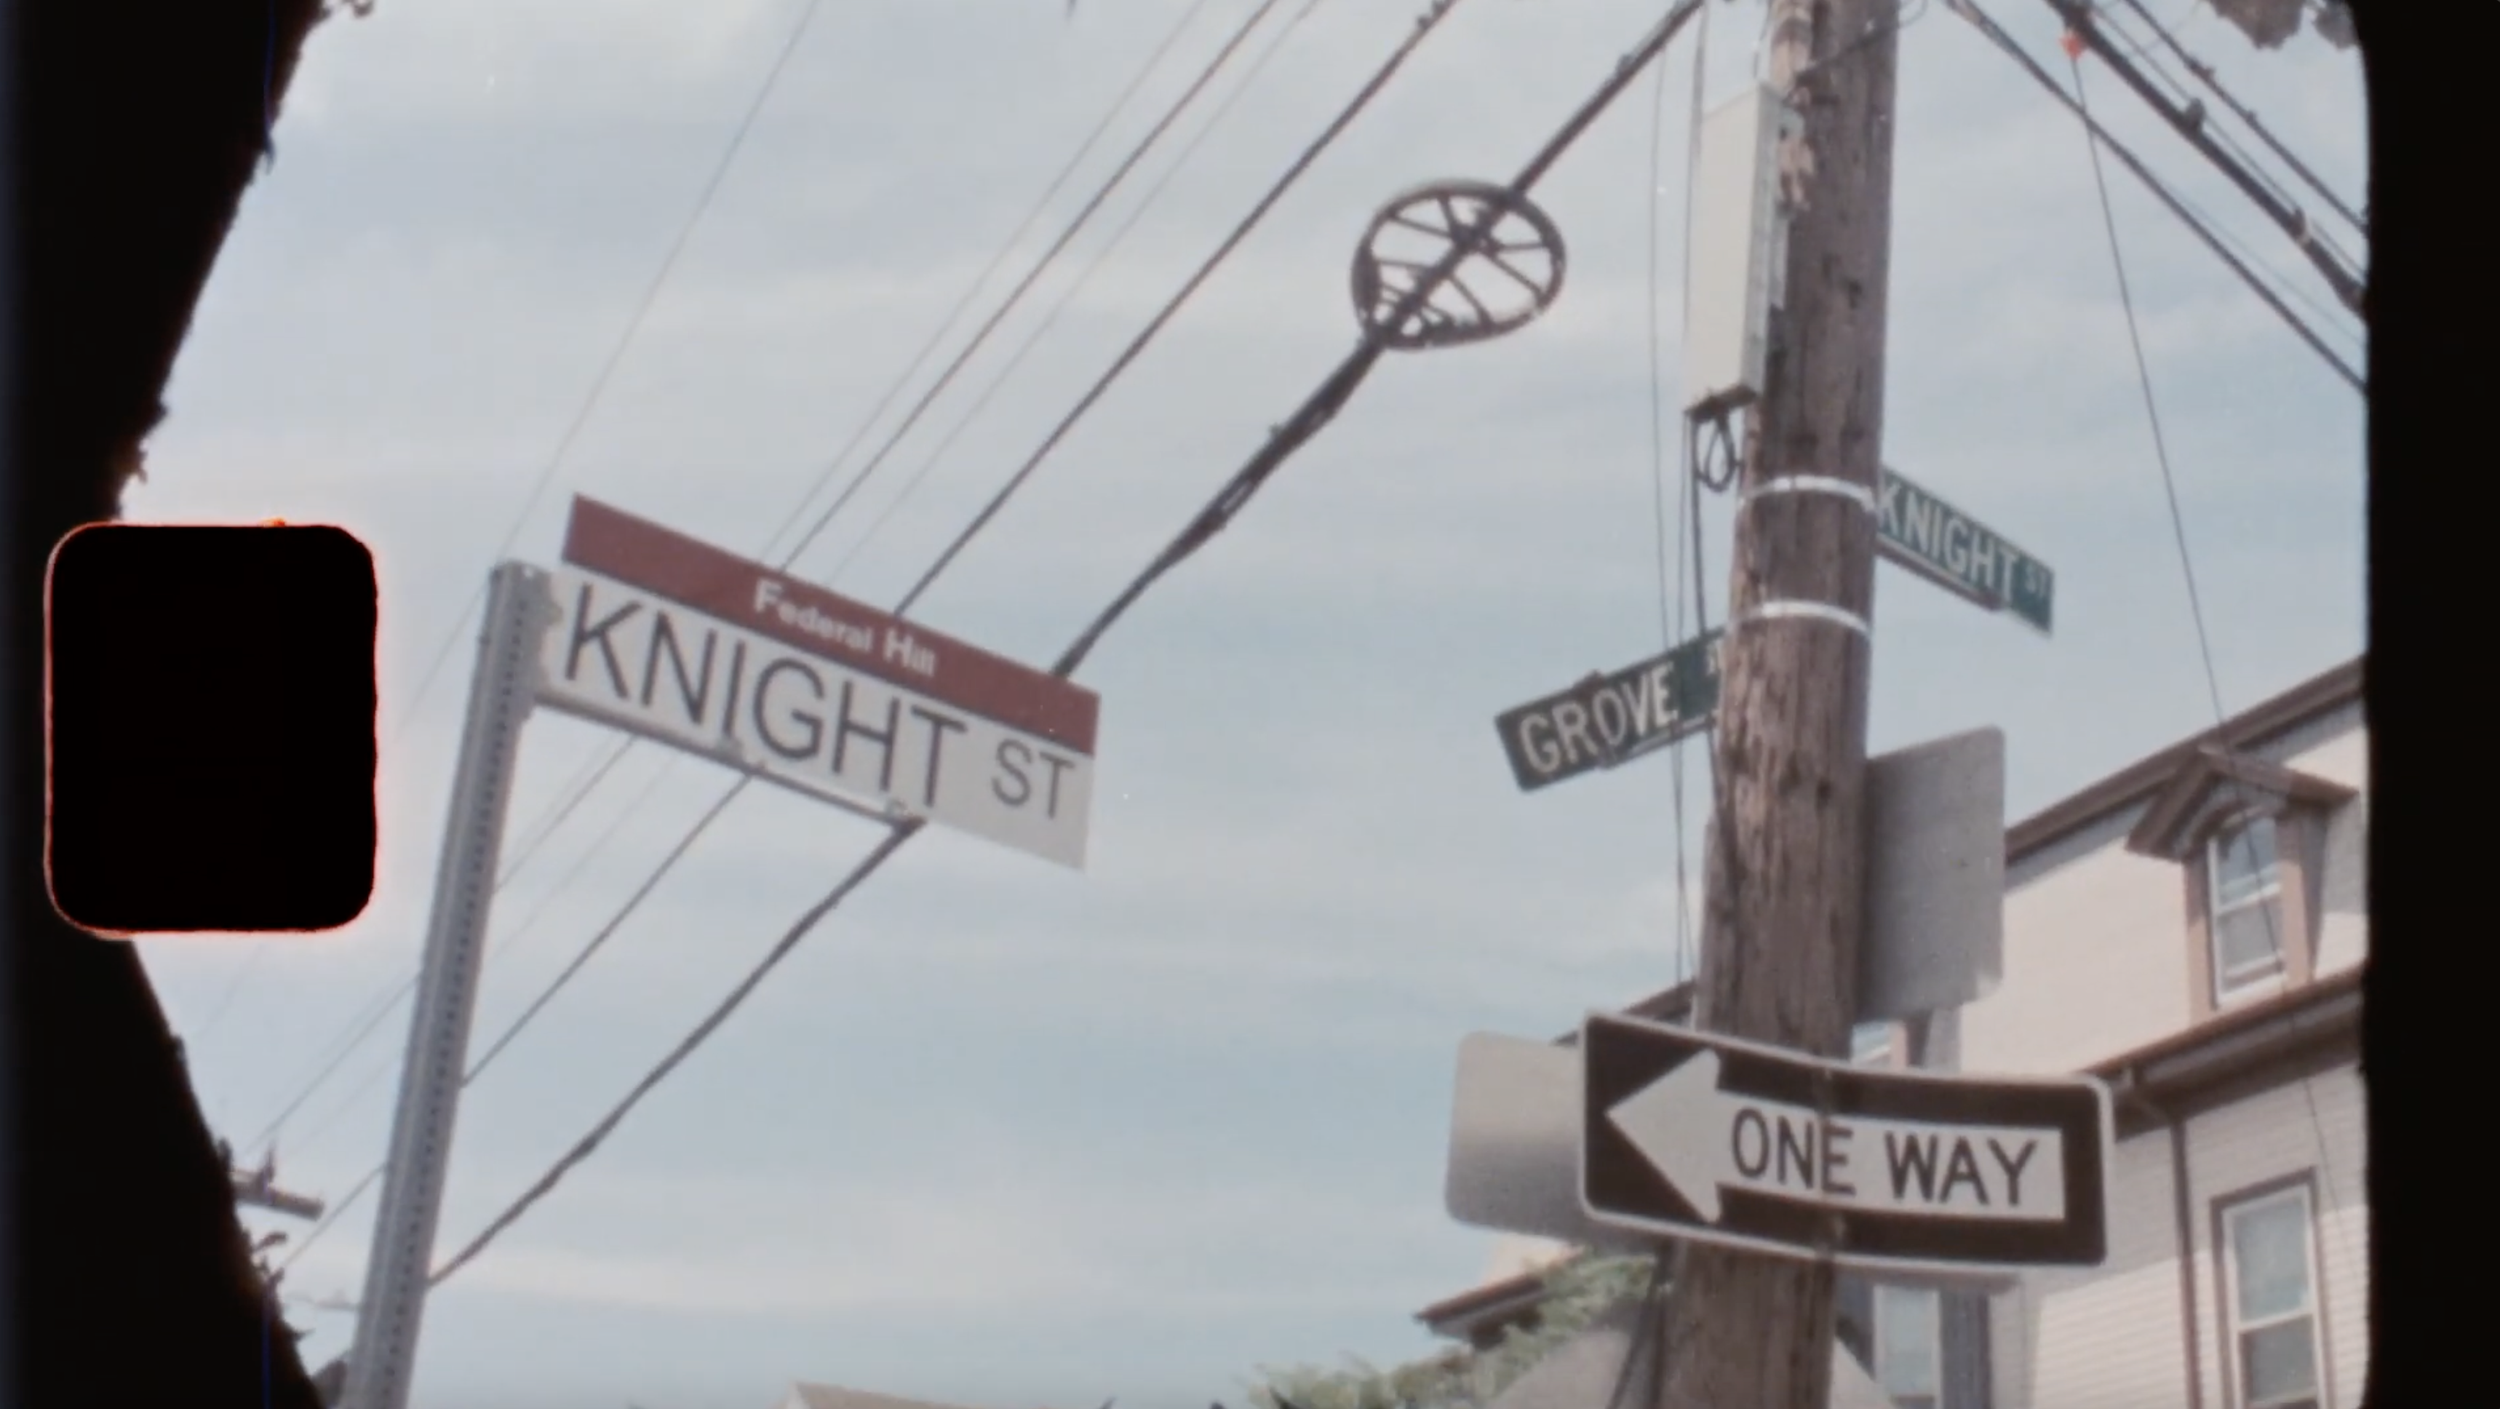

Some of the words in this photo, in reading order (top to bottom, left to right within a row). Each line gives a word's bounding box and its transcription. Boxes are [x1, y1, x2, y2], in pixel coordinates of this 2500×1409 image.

[1876, 478, 2022, 602] KNIGHT
[2024, 560, 2050, 599] ST
[754, 576, 873, 653] Federal
[883, 626, 937, 678] Hill
[565, 582, 968, 808] KNIGHT
[989, 738, 1077, 819] ST
[1519, 660, 1679, 773] GROVE
[1731, 1107, 1857, 1196] ONE
[1885, 1132, 2039, 1206] WAY
